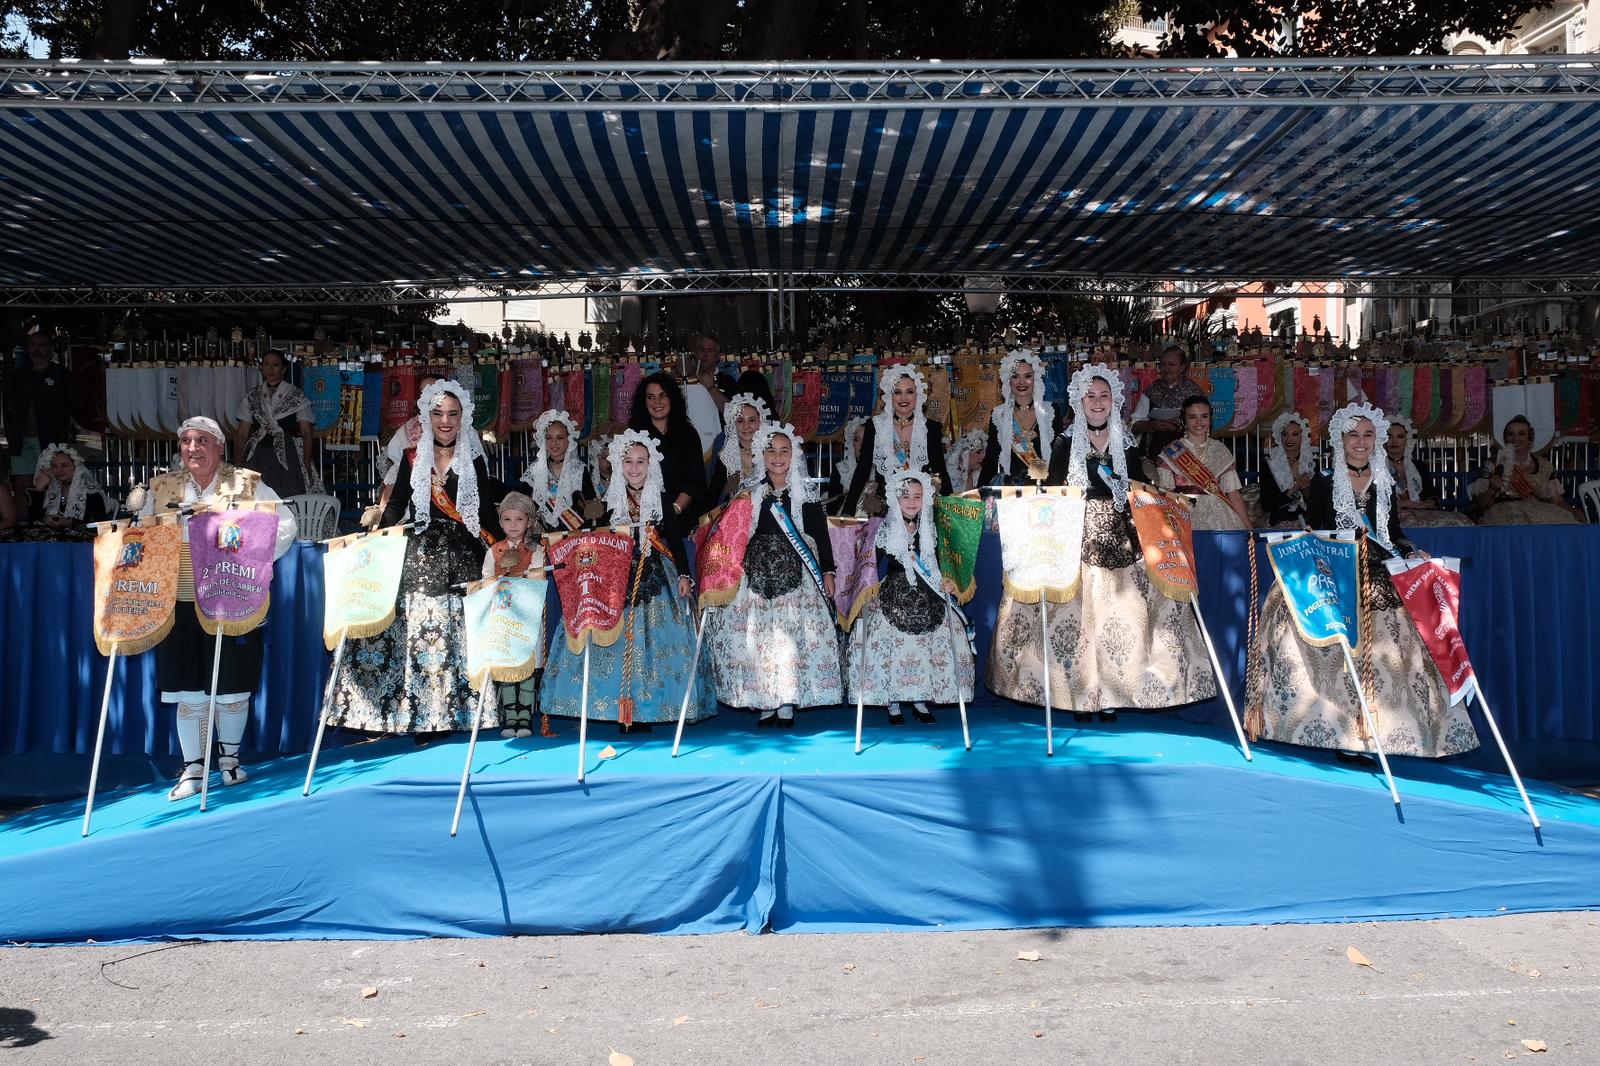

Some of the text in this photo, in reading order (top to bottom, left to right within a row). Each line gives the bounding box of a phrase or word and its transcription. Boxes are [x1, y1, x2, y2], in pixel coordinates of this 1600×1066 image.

[819, 404, 840, 413] REMI
[1277, 541, 1309, 559] JUNTA
[215, 561, 256, 580] PREMI
[578, 573, 603, 584] REMI
[219, 578, 231, 586] DE
[232, 580, 263, 595] CARRER
[1403, 577, 1423, 601] PREMI
